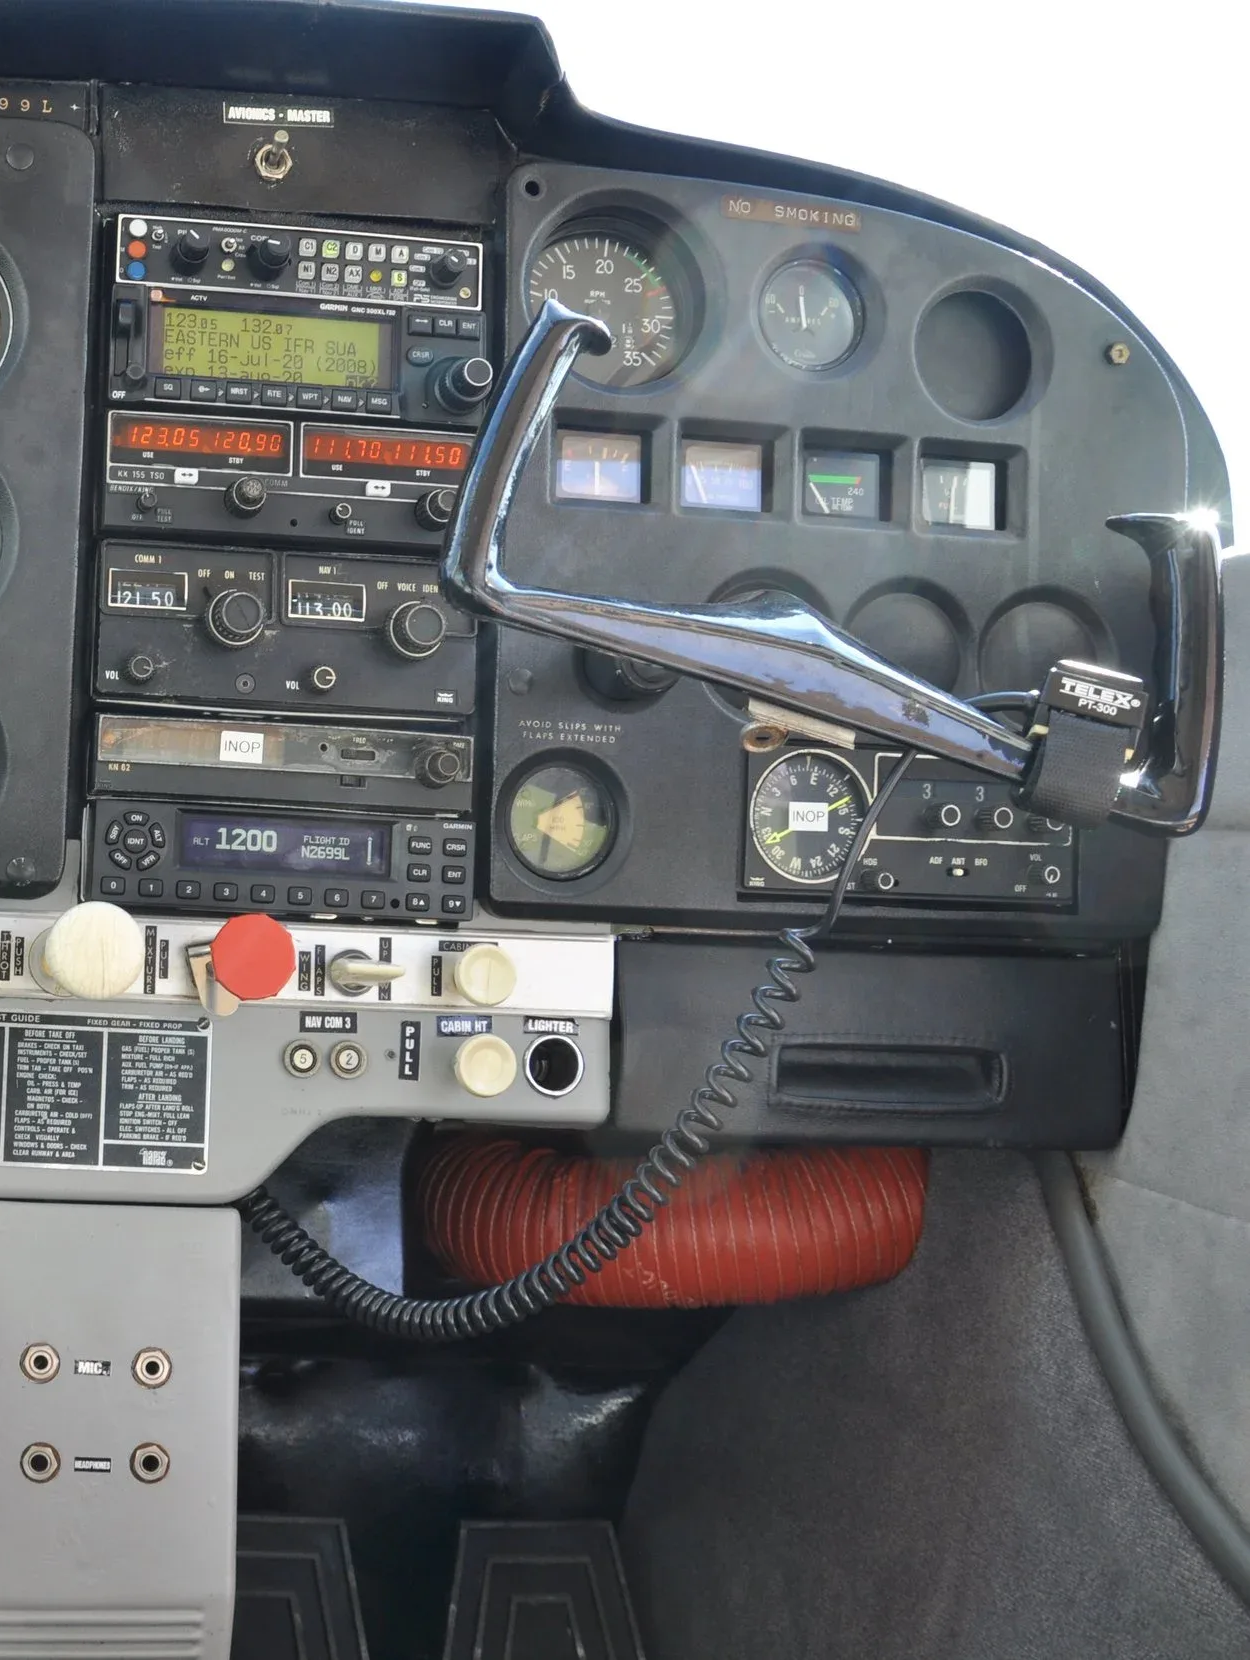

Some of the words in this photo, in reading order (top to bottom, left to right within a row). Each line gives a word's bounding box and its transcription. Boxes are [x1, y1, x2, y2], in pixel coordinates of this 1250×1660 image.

[228, 106, 275, 121] AVIONICS
[287, 109, 331, 123] MASTER
[729, 200, 750, 214] NO
[774, 205, 855, 226] SMOKING
[305, 242, 314, 250] C1
[327, 243, 337, 251] C2
[349, 269, 360, 277] AX
[596, 260, 614, 274] 20
[625, 278, 642, 293] 25
[320, 303, 348, 312] GARMIN
[165, 313, 217, 330] 123.05
[241, 318, 293, 335] 132.07
[439, 319, 453, 328] CLR
[462, 322, 476, 330] ENT
[641, 319, 660, 333] 30
[164, 330, 240, 348] EASTERN
[251, 335, 272, 351] US
[285, 340, 315, 354] IFR
[325, 341, 357, 356] SUA
[412, 350, 429, 358] CRSR
[623, 351, 642, 366] 35
[164, 348, 195, 360] eff
[208, 350, 304, 369] 16-jul-20
[316, 358, 376, 377] (2008)
[163, 383, 174, 392] SQ
[231, 387, 248, 396] NRST
[268, 389, 282, 398] RTE
[112, 389, 126, 399] OFF
[302, 392, 318, 400] WPT
[338, 395, 352, 403] NAV
[371, 397, 387, 405] MSG
[131, 427, 199, 447] 123.05
[214, 432, 281, 452] 120.90
[315, 438, 380, 459] 111.70
[396, 444, 461, 464] 111.50
[118, 470, 129, 478] KX
[131, 471, 146, 479] 155
[150, 472, 164, 480] TSO
[332, 463, 343, 471] USE
[416, 468, 431, 477] STBY
[134, 554, 155, 563] COMM
[198, 568, 211, 578] OFF
[224, 570, 235, 579] ON
[249, 571, 265, 581] TEST
[318, 566, 332, 574] NAV
[377, 581, 388, 590] OFF
[397, 582, 416, 592] VOICE
[105, 670, 119, 680] VOL
[286, 680, 300, 690] VOL
[1060, 677, 1133, 710] TELEX
[1078, 698, 1117, 716] PT-300
[519, 720, 551, 728] AVOID
[558, 722, 586, 731] SLIPS
[594, 724, 621, 732] WITH
[523, 731, 553, 740] FLAPS
[560, 733, 615, 743] EXTENDED
[224, 739, 261, 754] INOP
[131, 814, 142, 822] ON
[793, 809, 825, 823] INOP
[110, 825, 119, 840] SBY
[153, 829, 163, 843] ALT
[193, 837, 210, 846] ALT
[215, 827, 277, 852] 1200
[304, 836, 337, 845] FLIGHT
[340, 837, 350, 845] ID
[301, 844, 350, 860] N2699L
[412, 841, 431, 849] FUNC
[446, 843, 466, 852] CRSR
[114, 852, 128, 865] OFF
[141, 854, 156, 867] VFR
[929, 856, 943, 865] ADF
[952, 857, 965, 866] ANT
[975, 858, 988, 866] BFO
[1029, 853, 1042, 861] VOL
[413, 868, 427, 876] CLR
[448, 871, 461, 879] ENT
[110, 882, 116, 890] 0
[186, 886, 191, 894] 2
[223, 888, 229, 896] 3
[334, 893, 340, 901] 6
[371, 895, 376, 903] 7
[1014, 885, 1027, 893] OFF
[11, 1013, 40, 1023] GUIDE
[305, 1016, 323, 1028] NAV
[325, 1016, 342, 1029] COM
[344, 1017, 350, 1029] 3
[87, 1019, 109, 1027] FIXED
[162, 1022, 182, 1030] PROP
[441, 1020, 471, 1033] CABIN
[475, 1020, 487, 1033] HT
[528, 1019, 573, 1033] LIGHTER
[405, 1026, 414, 1076] PULL
[78, 1362, 108, 1374] MIC.
